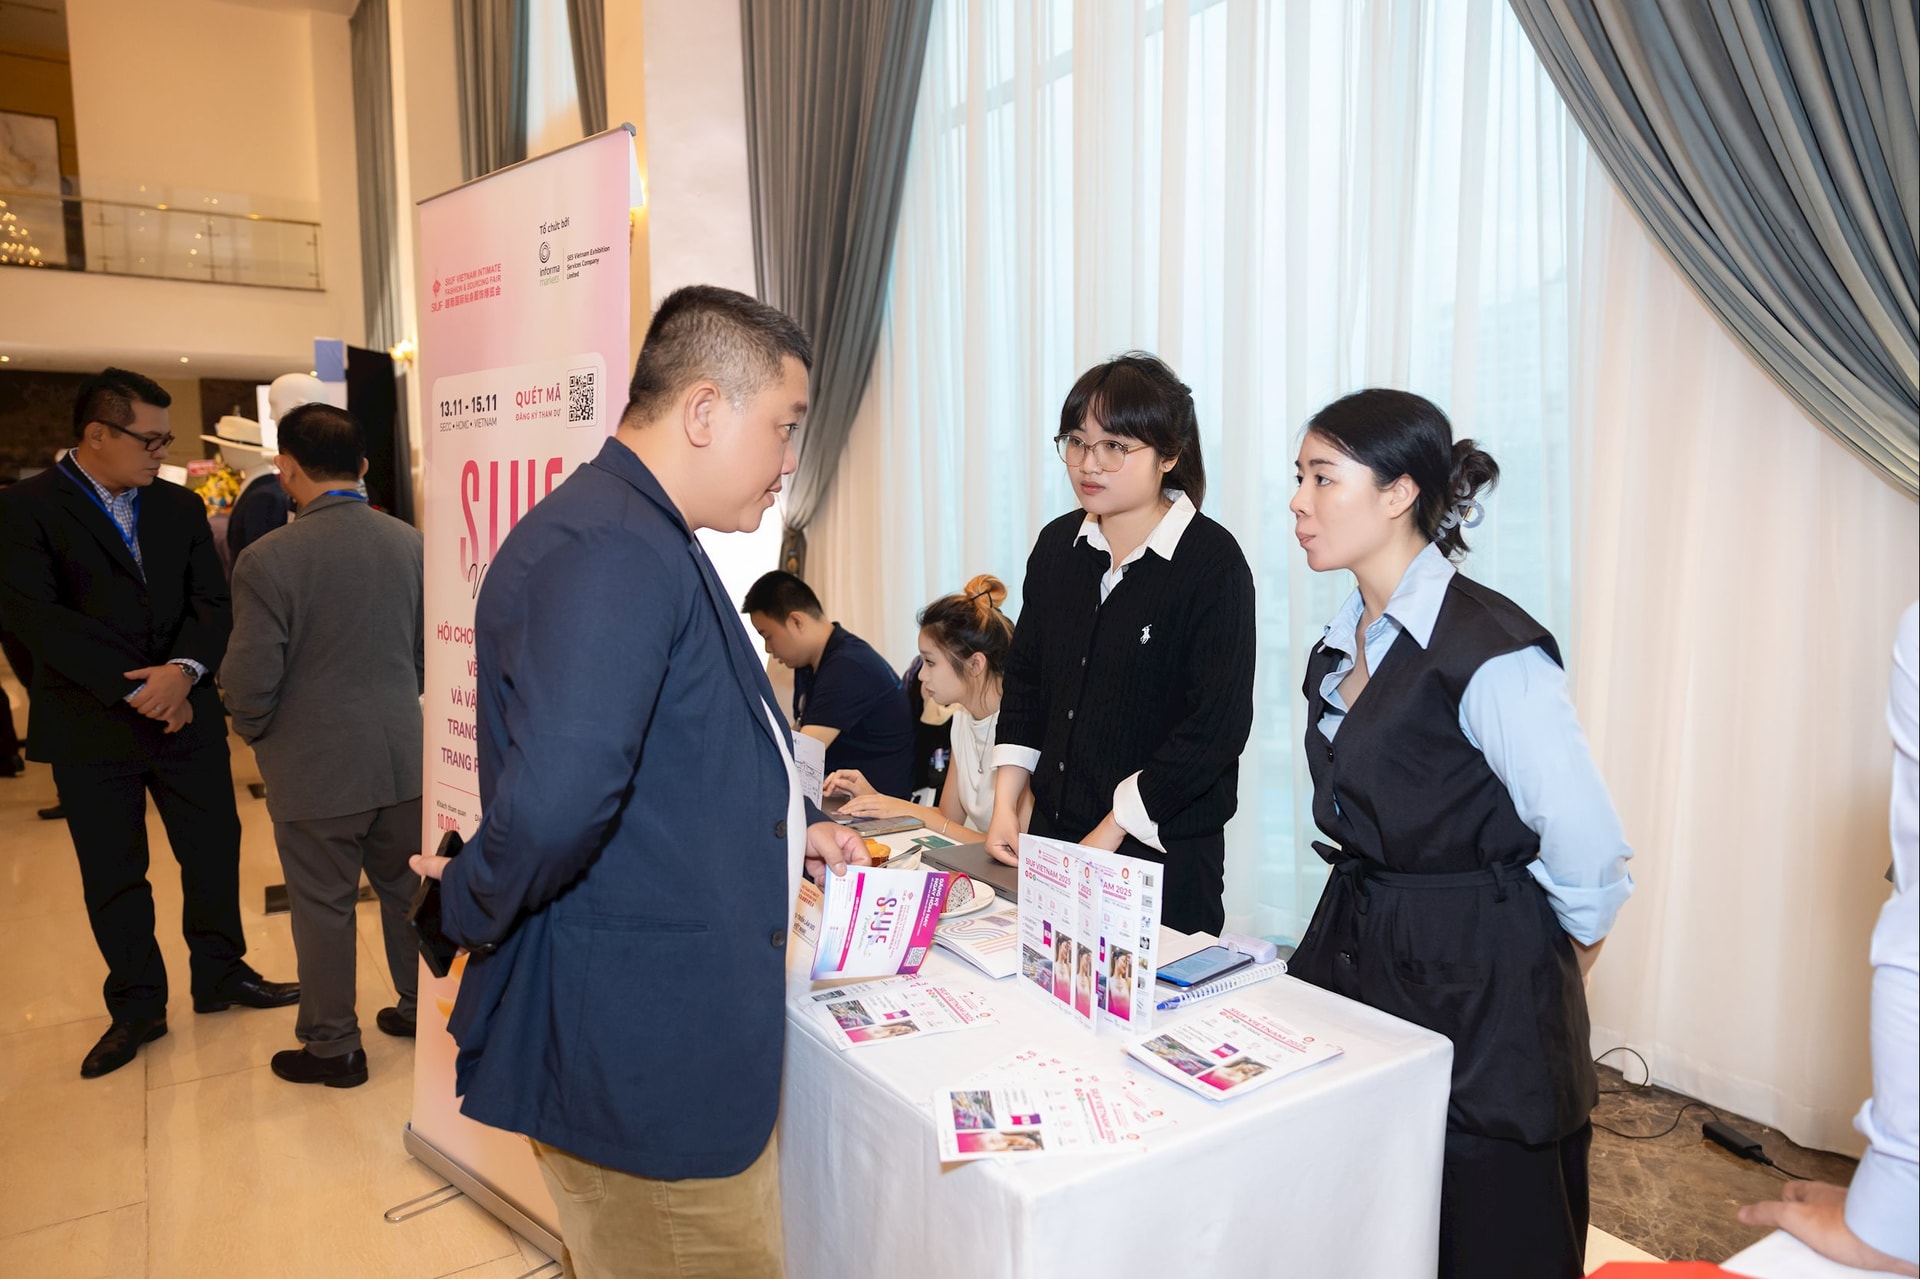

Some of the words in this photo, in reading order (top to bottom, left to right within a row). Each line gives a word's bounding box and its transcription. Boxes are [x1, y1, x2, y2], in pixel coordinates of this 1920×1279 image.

[539, 221, 548, 235] Tổ
[574, 250, 590, 260] Vietnam
[590, 246, 610, 256] Exhibition
[540, 264, 560, 276] informa
[566, 262, 582, 270] Services
[582, 258, 600, 267] Company
[445, 276, 456, 286] SIUF
[456, 270, 477, 282] VIETNAM
[478, 263, 502, 277] INTIMATE
[540, 275, 560, 287] markets
[566, 270, 580, 280] Limited
[444, 285, 462, 294] FASHION
[467, 277, 488, 290] SOURCING
[489, 274, 502, 282] FAIR
[431, 300, 444, 312] SIUF
[515, 386, 543, 408] QUÉT
[546, 382, 562, 402] MÃ
[440, 398, 462, 418] 13.11
[472, 394, 497, 414] 15.11
[515, 412, 530, 421] ĐĂNG
[539, 409, 553, 418] THAM
[440, 422, 452, 432] SECC
[474, 417, 498, 428] VIETNAM
[437, 620, 452, 644] HỘI
[454, 626, 476, 648] CHỢ
[450, 684, 464, 706] VÀ
[441, 746, 472, 771] TRANG
[1026, 857, 1036, 868] SIUF
[1036, 862, 1058, 878] VIETNAM
[1058, 874, 1072, 886] 2025
[1115, 884, 1132, 898] 2025
[1248, 1018, 1287, 1040] VIETNAM
